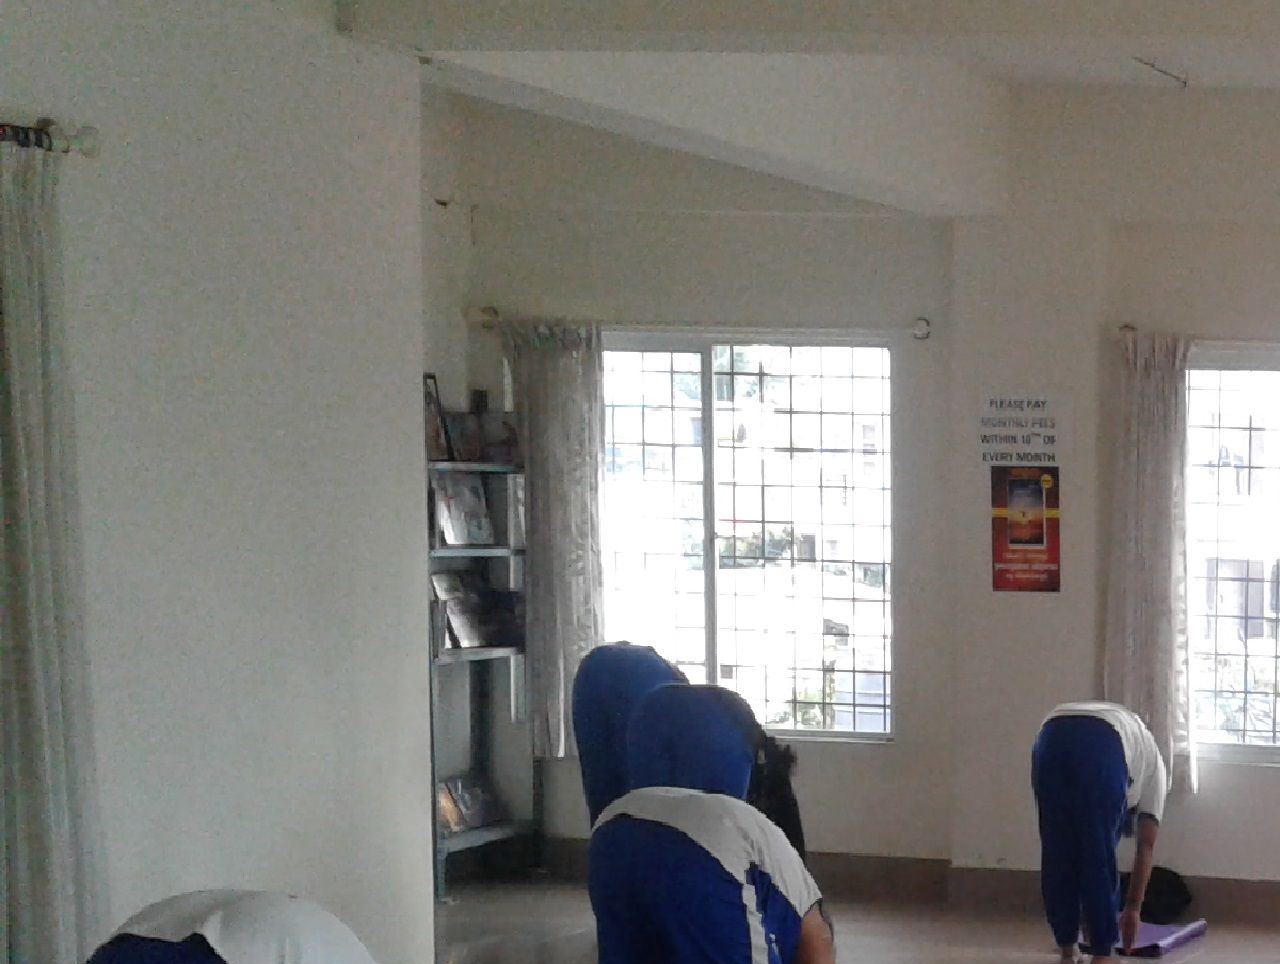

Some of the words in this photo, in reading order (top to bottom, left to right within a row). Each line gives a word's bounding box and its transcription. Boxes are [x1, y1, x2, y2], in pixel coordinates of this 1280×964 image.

[1026, 400, 1048, 409] PAY
[982, 452, 1013, 462] EVERY
[1015, 452, 1056, 462] MONTH
